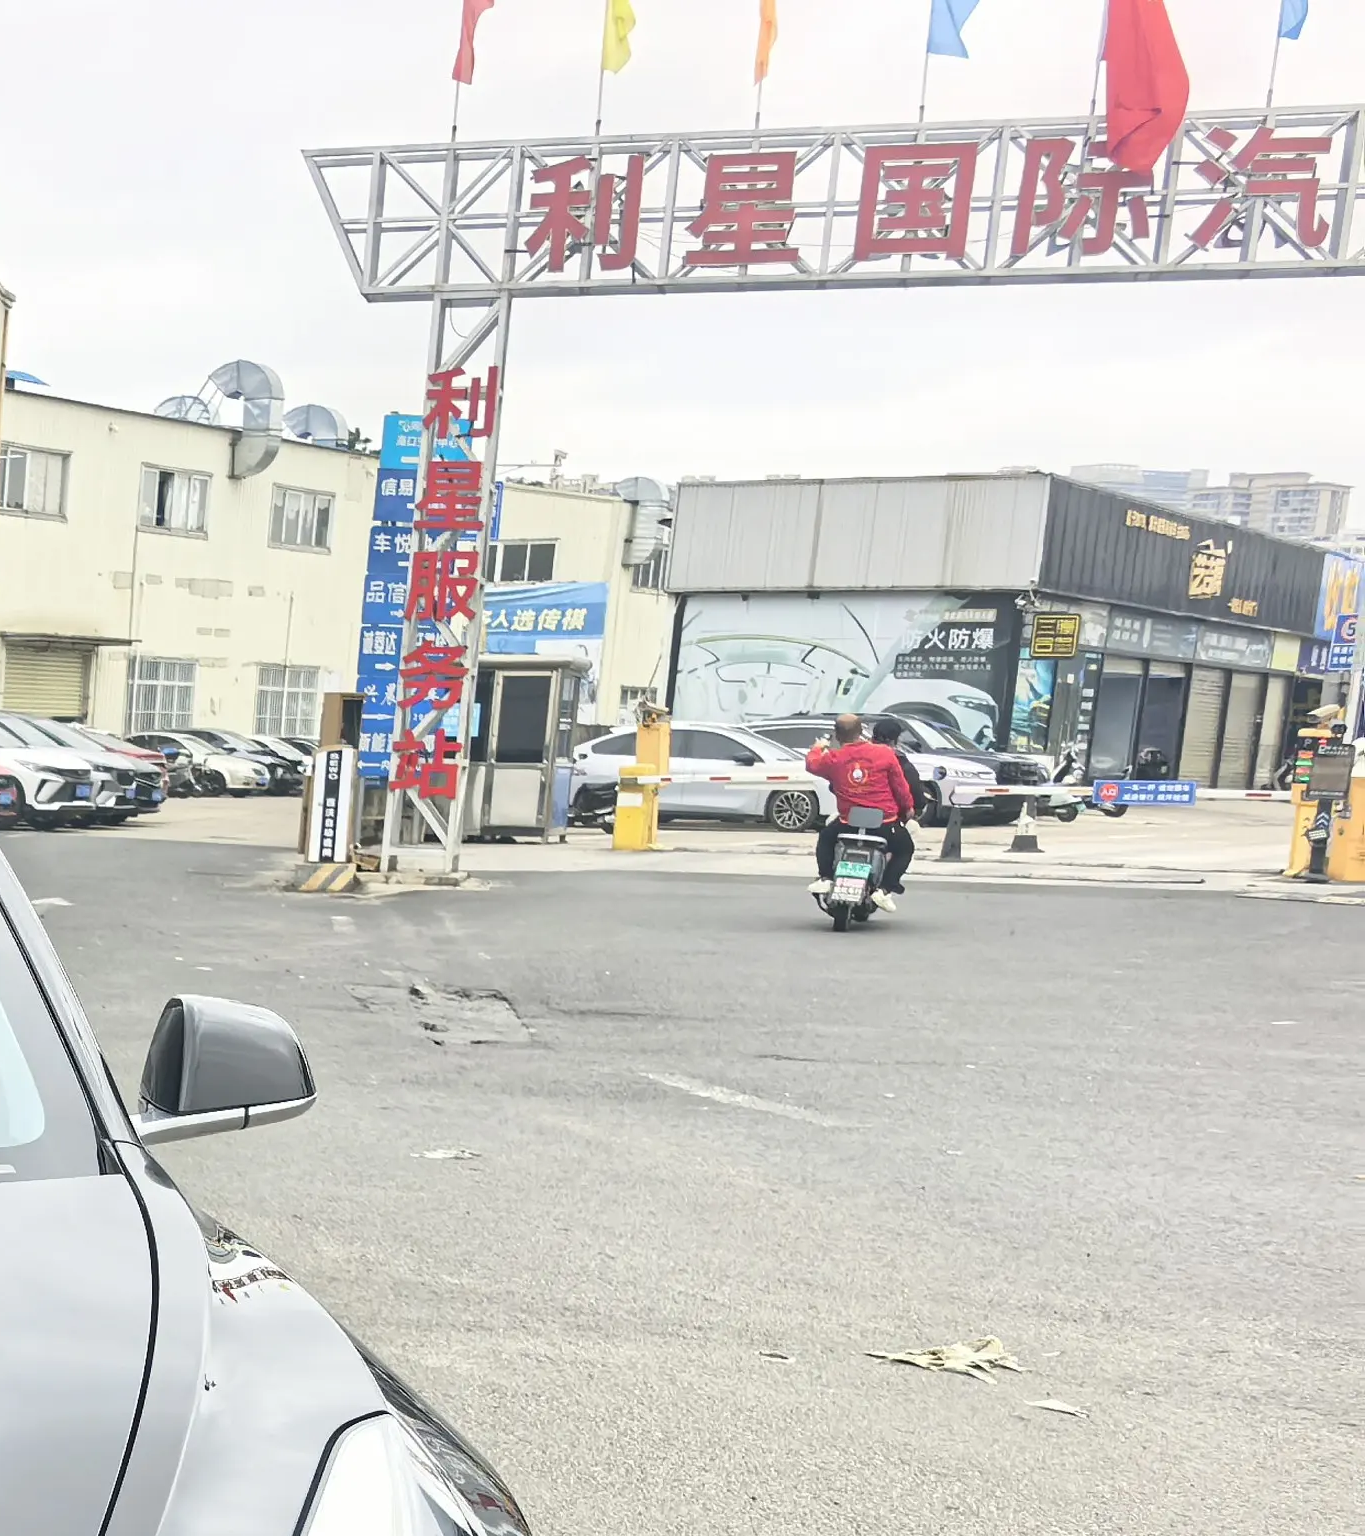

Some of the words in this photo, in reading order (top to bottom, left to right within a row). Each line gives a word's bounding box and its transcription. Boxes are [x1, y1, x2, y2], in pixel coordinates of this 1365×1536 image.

[388, 366, 499, 800] 利星服务站
[900, 627, 995, 650] 防火防爆
